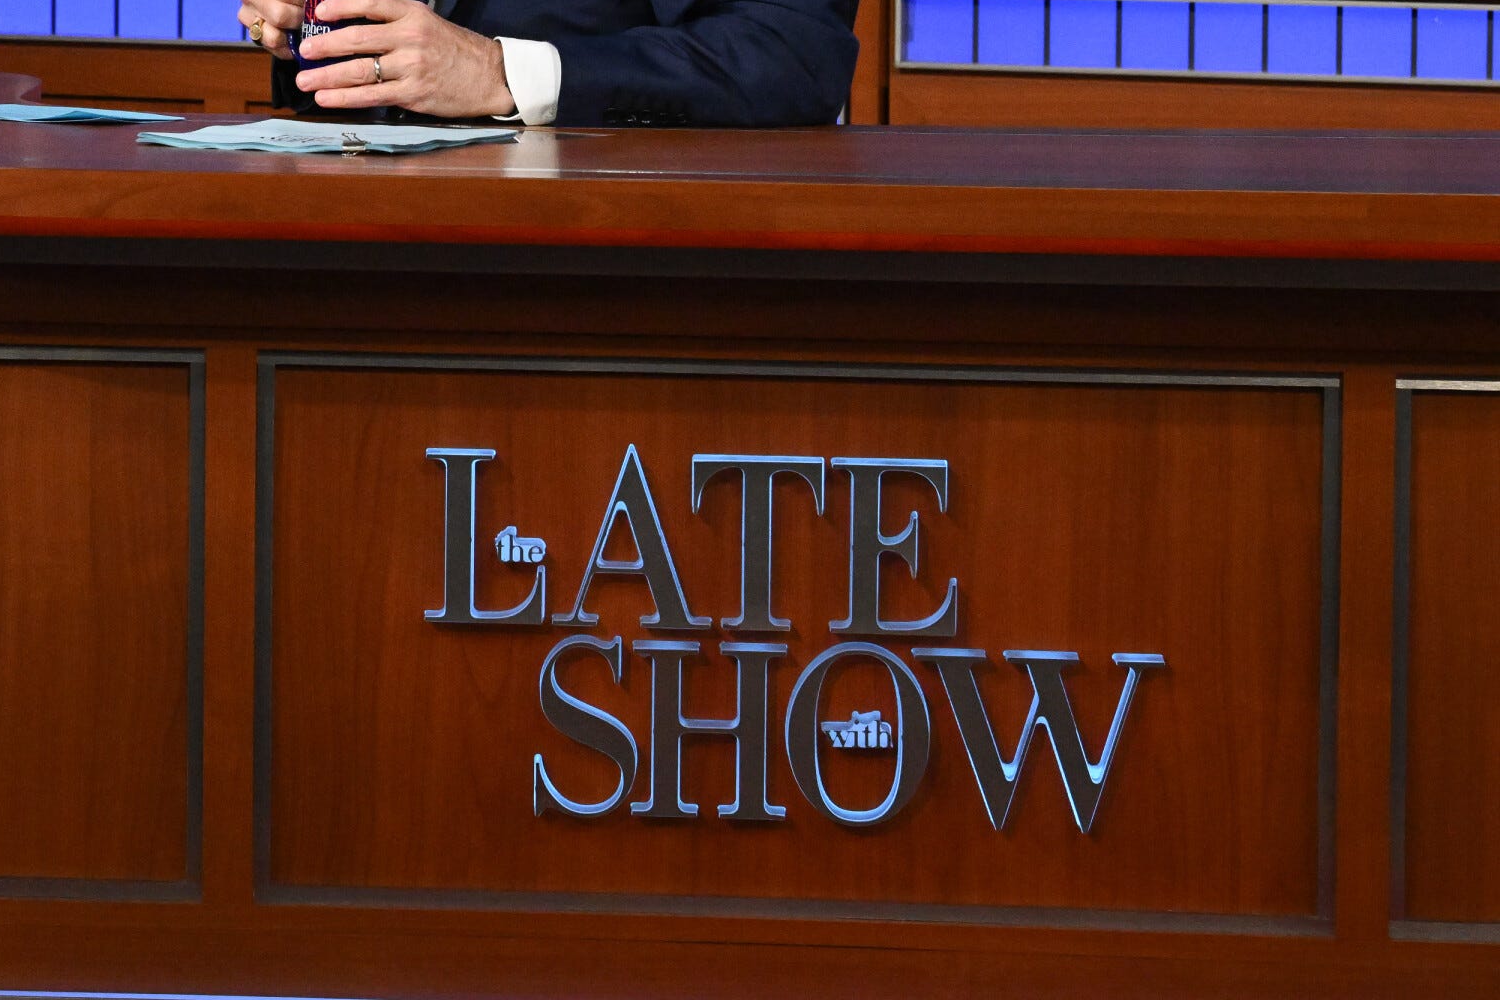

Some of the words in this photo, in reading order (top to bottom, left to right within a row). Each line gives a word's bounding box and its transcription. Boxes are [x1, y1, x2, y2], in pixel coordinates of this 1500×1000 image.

[424, 443, 957, 636] LATE
[495, 528, 546, 563] the
[532, 635, 1165, 834] SHOW
[822, 713, 893, 749] with
